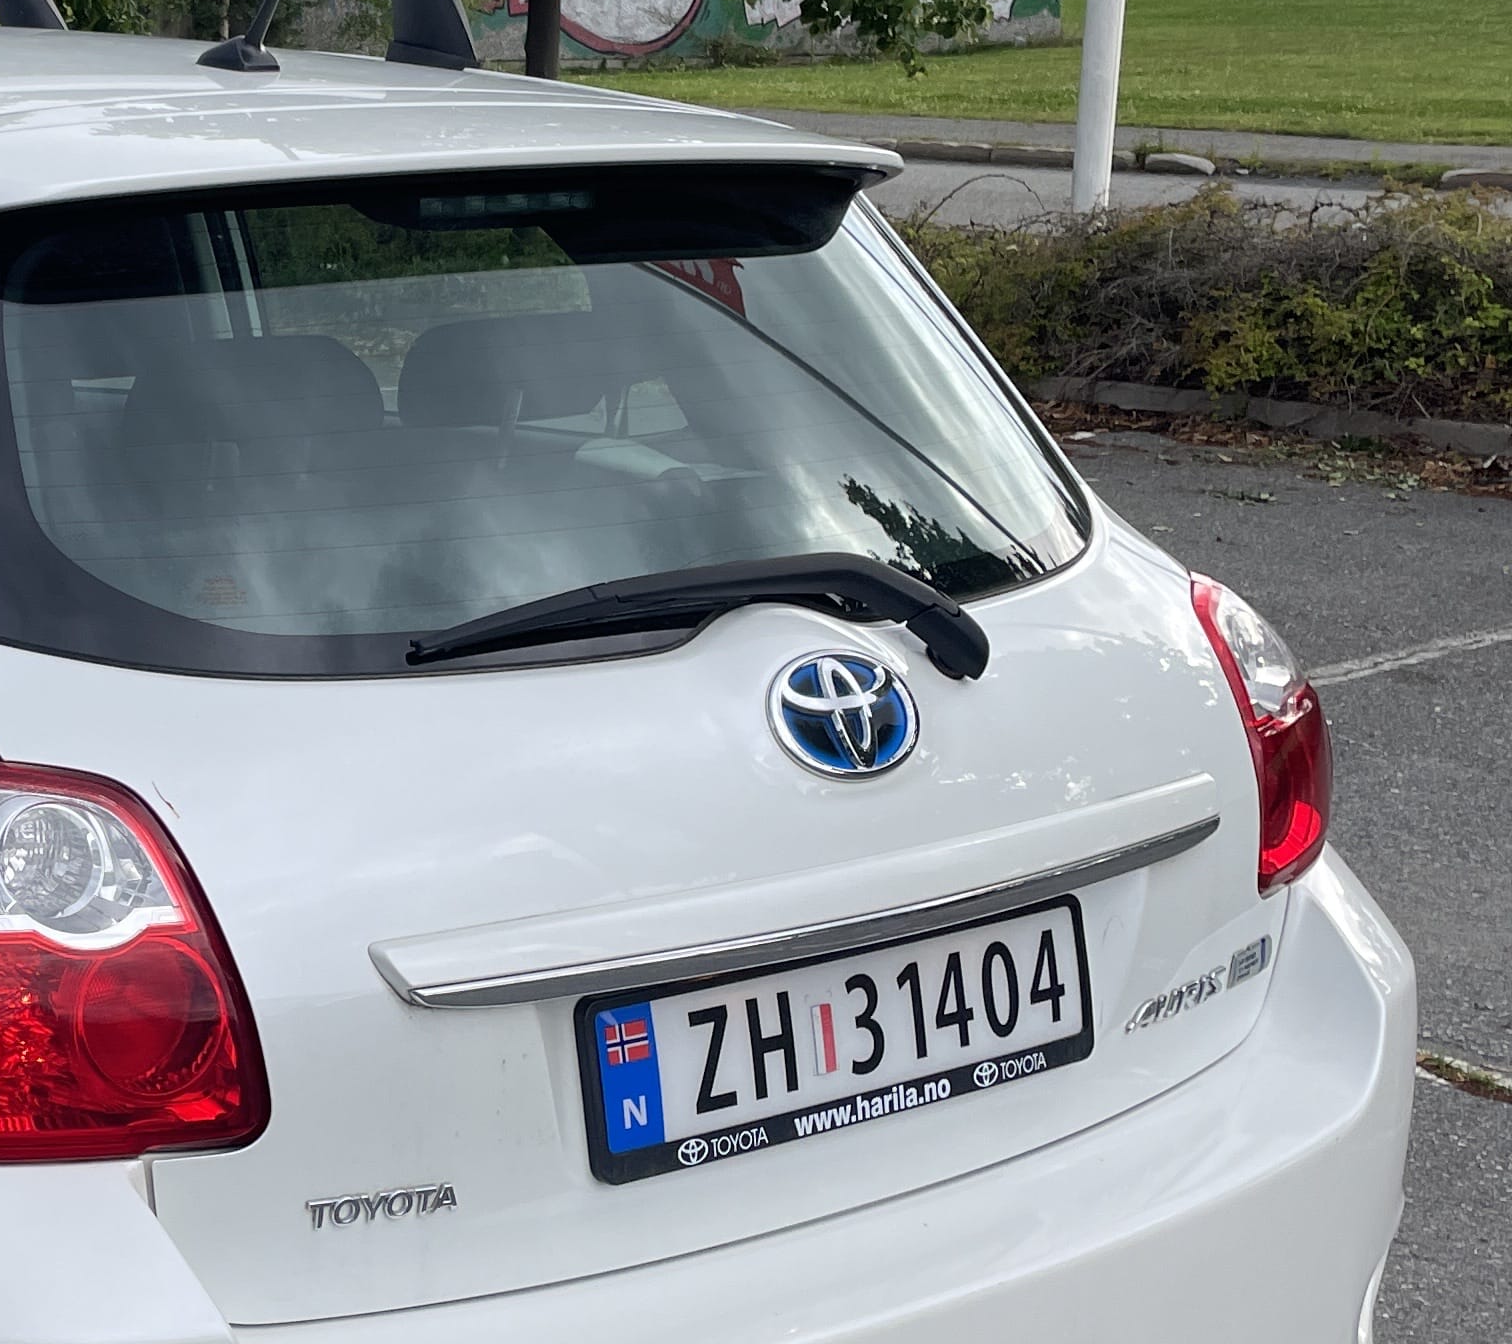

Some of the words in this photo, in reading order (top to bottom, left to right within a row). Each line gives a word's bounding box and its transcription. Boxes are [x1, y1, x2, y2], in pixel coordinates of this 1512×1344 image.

[688, 991, 799, 1115] ZH
[845, 928, 1065, 1076] 31404
[1000, 1052, 1047, 1080] TOYOTA
[622, 1095, 648, 1130] N
[794, 1078, 951, 1137] www.harila.no
[710, 1126, 769, 1158] TOYOTA
[305, 1181, 459, 1231] TOYOTA
